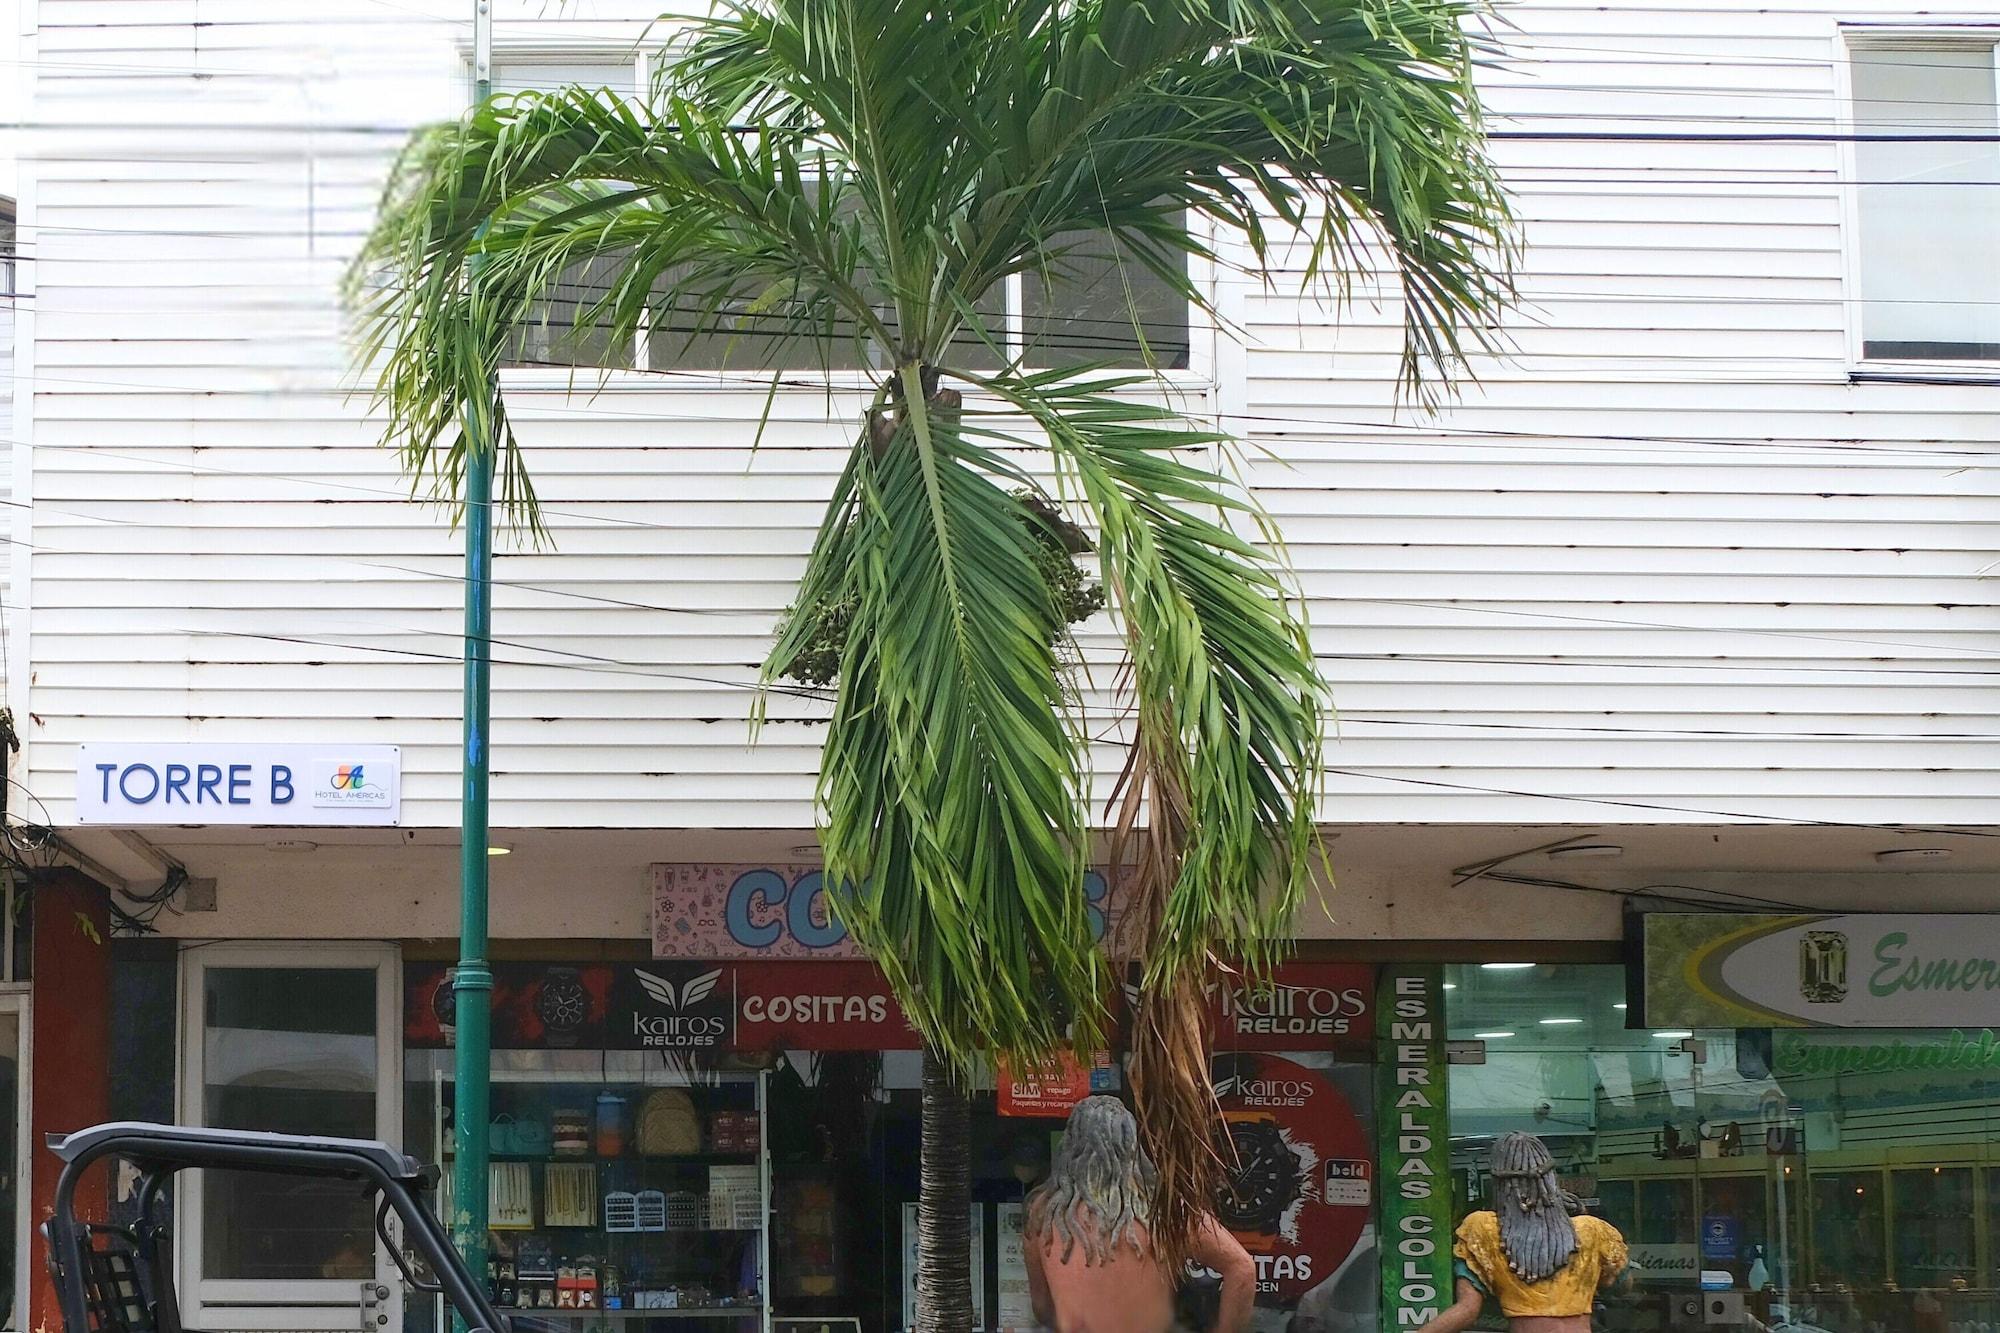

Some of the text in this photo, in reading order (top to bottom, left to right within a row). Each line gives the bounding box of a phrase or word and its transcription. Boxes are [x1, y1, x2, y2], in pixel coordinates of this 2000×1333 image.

[96, 763, 295, 804] TORRE B
[346, 792, 385, 800] AMERICAS
[1868, 931, 2000, 997] Esmer
[743, 995, 887, 1023] COSITAS
[1222, 980, 1366, 1017] kairos
[633, 1011, 725, 1035] kairos
[1237, 1018, 1349, 1034] RELOJES
[643, 1035, 714, 1046] RELOJES
[1776, 1028, 2000, 1073] Esmerald
[1014, 1084, 1039, 1095] SIM
[1236, 1075, 1314, 1097] kairos
[1391, 977, 1433, 1199] ESMERALDAS
[1244, 1097, 1305, 1107] RELOJES
[1332, 1163, 1364, 1177] bold
[1631, 1250, 1695, 1270] bianas
[1398, 1216, 1438, 1333] COLOM
